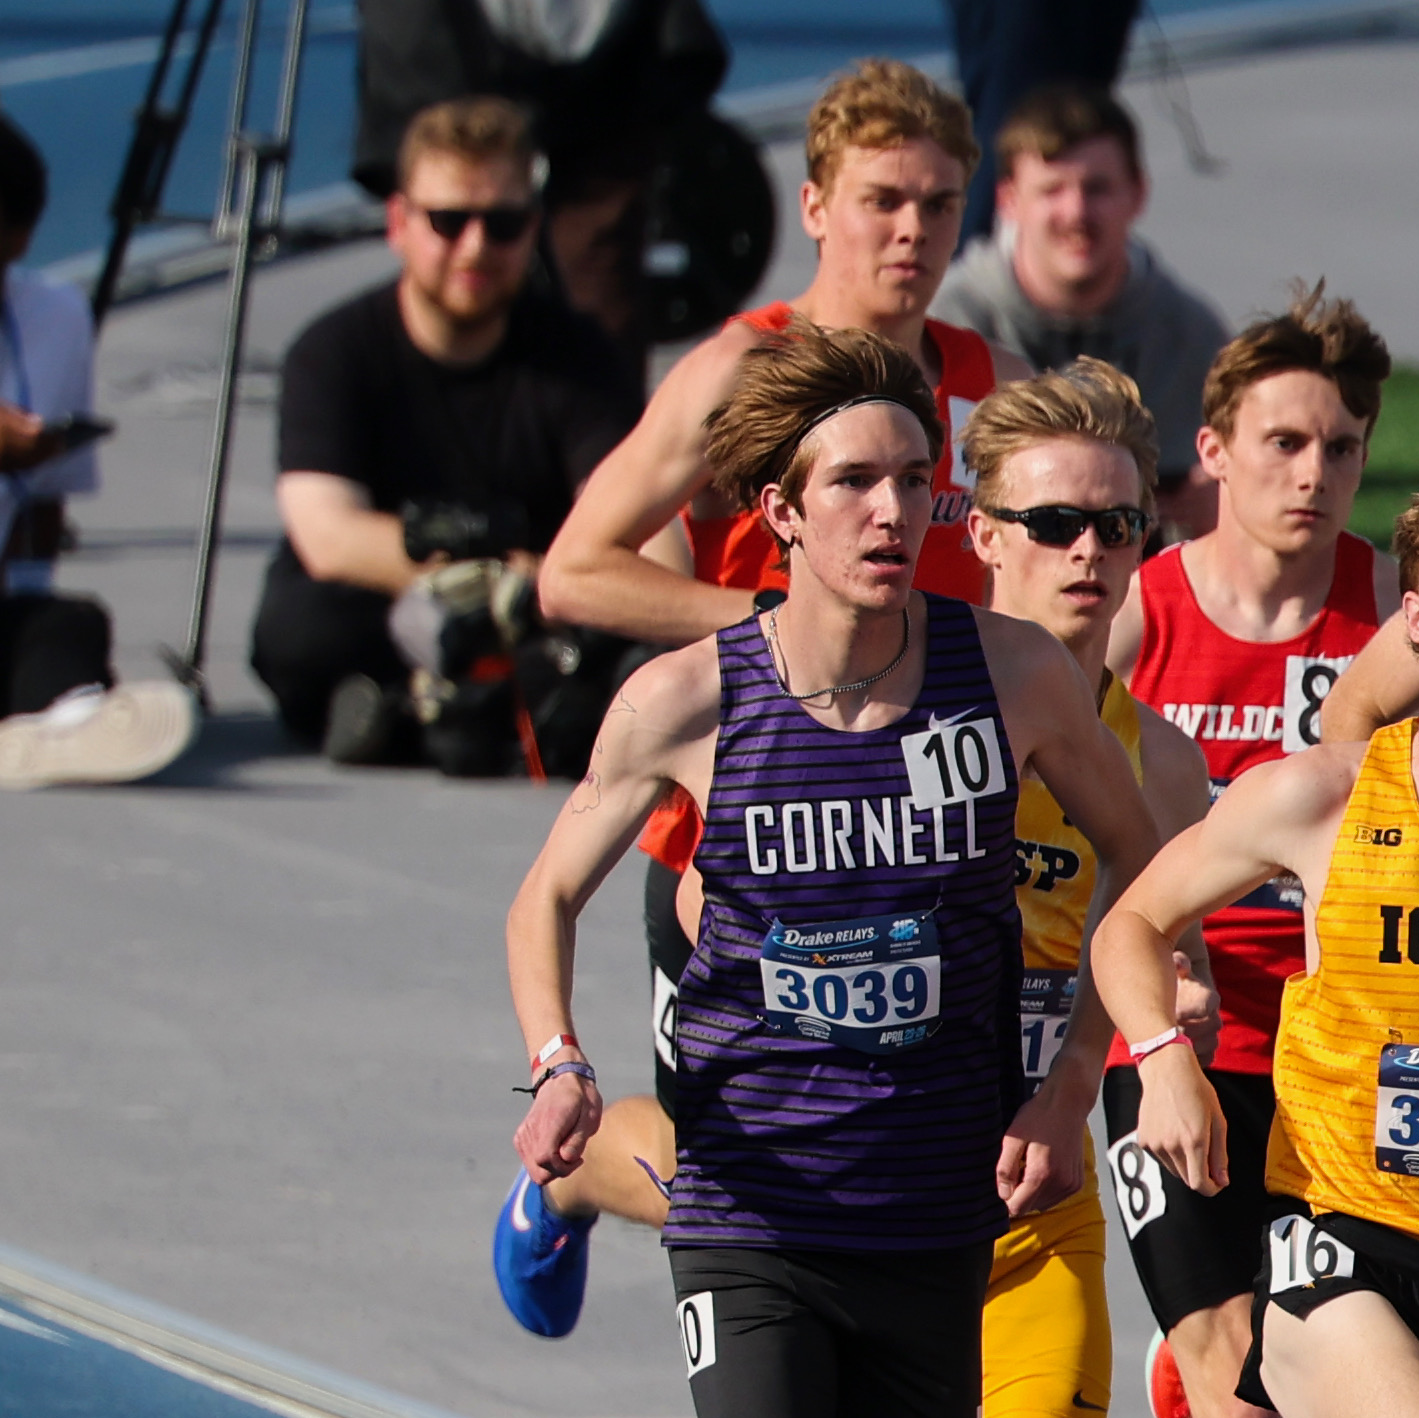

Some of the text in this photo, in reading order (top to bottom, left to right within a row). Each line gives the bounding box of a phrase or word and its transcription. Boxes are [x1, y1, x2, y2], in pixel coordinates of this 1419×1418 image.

[1298, 665, 1339, 746] 8
[923, 725, 989, 799] 10
[745, 796, 987, 875] CORNELL
[784, 927, 874, 946] Drake RELAYS
[775, 966, 928, 1023] 3039
[880, 1030, 903, 1044] APRIL
[1117, 1142, 1150, 1222] 8
[1280, 1217, 1339, 1284] 16
